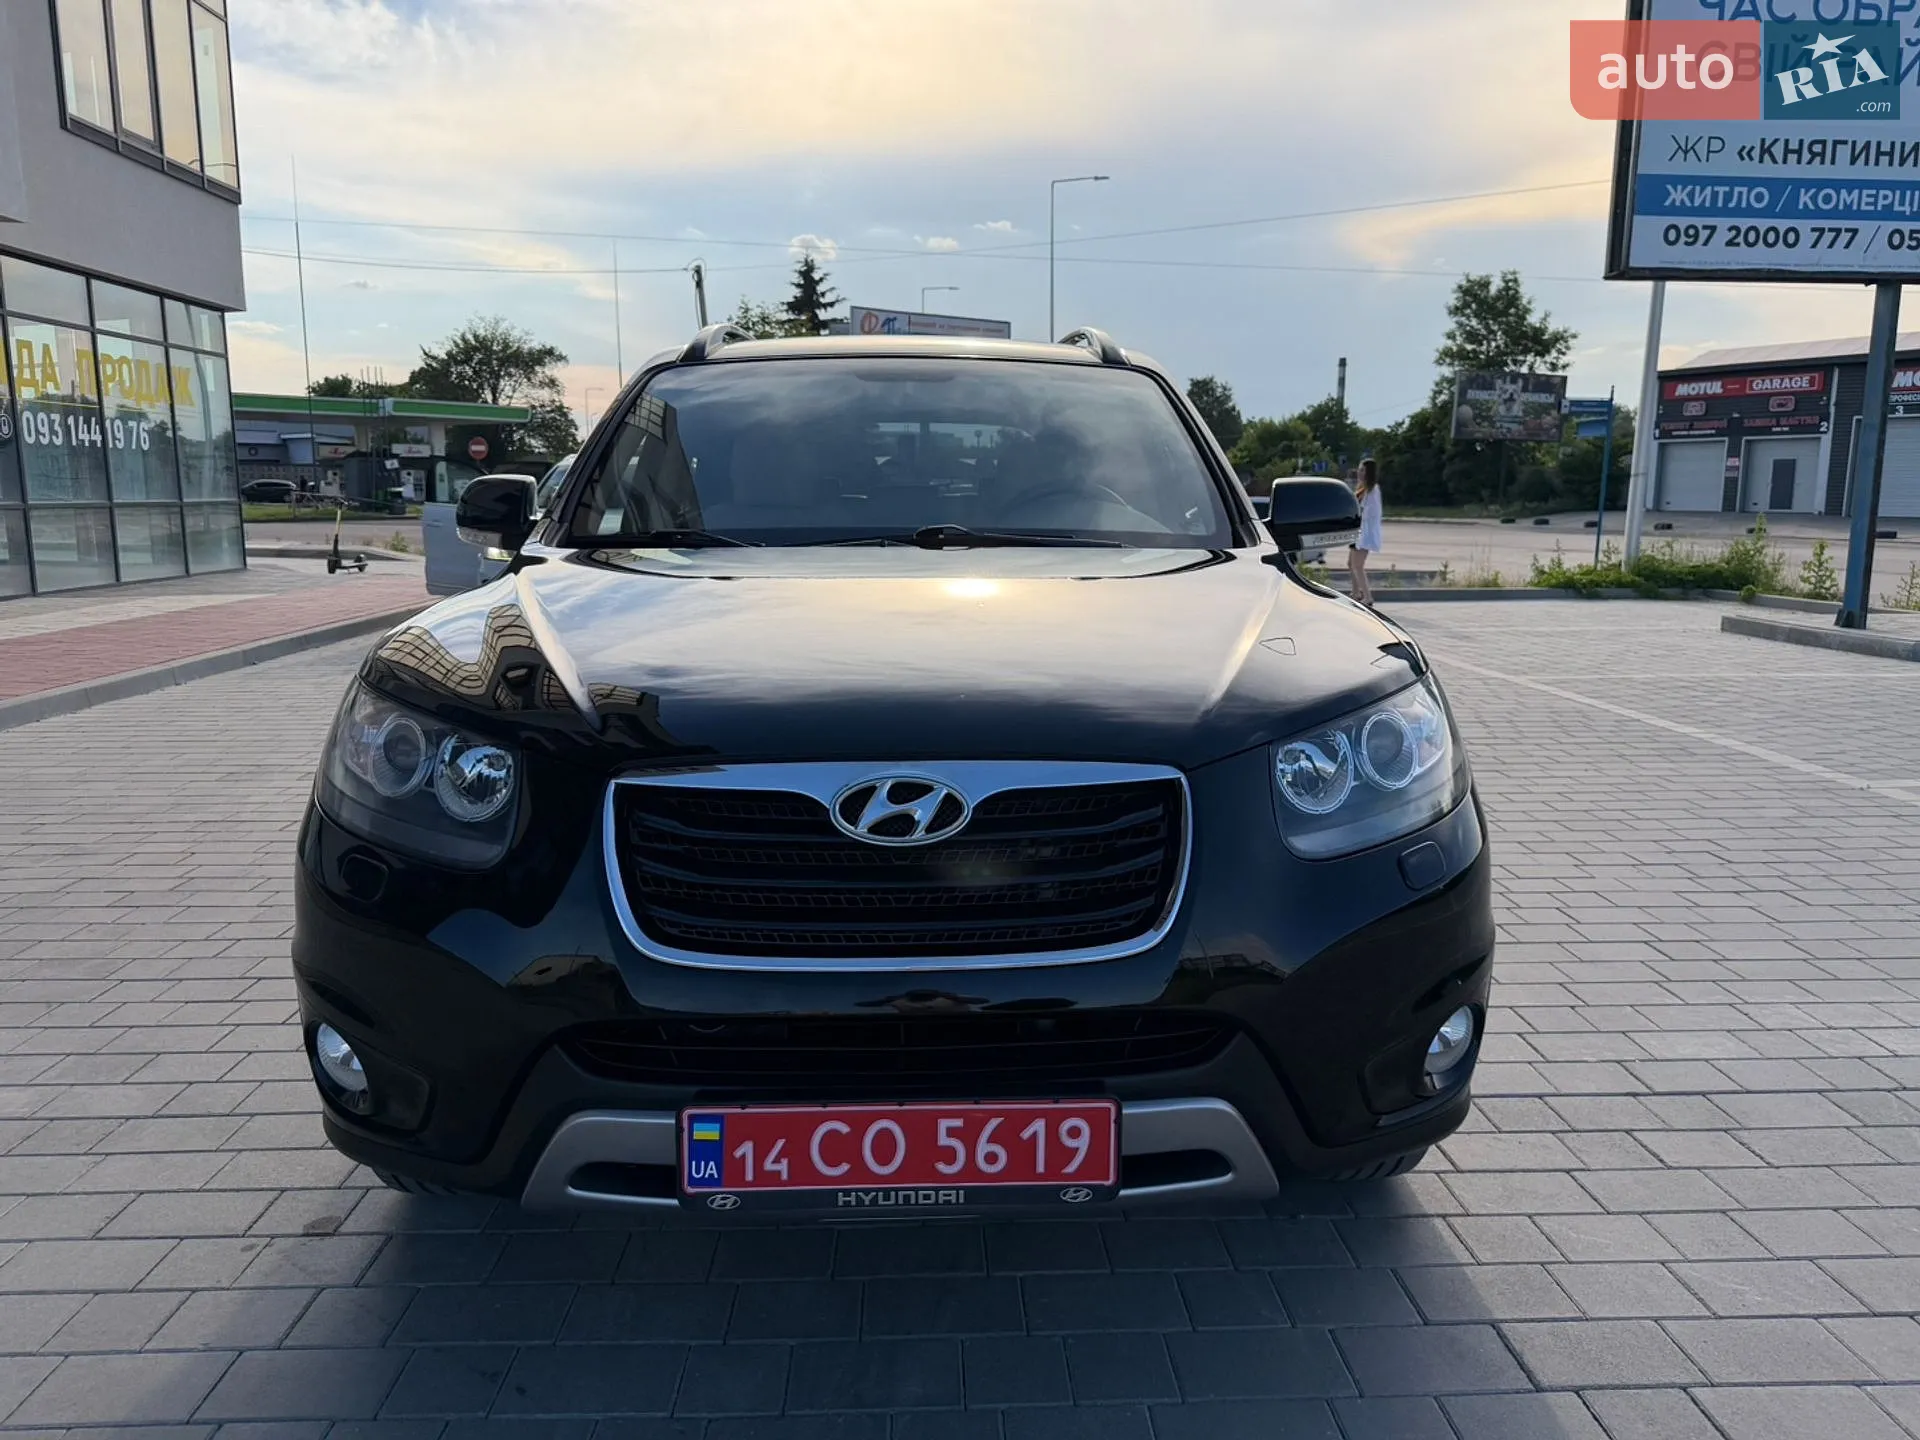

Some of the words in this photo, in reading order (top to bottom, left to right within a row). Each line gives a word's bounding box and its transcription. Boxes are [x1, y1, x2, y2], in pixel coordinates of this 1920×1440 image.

[1813, 0, 1920, 29] ОБР
[1668, 134, 1726, 163] ЖР
[1663, 184, 1770, 209] ЖИТЛО
[1662, 223, 1718, 247] 097
[1724, 225, 1801, 249] 2000
[1809, 227, 1860, 250] 777
[76, 348, 196, 410] ПРОДАЖ
[1675, 380, 1723, 396] MOTUL
[1752, 375, 1810, 391] GARAGE
[22, 411, 64, 445] 093
[67, 414, 103, 448] 144
[105, 418, 125, 449] 19
[128, 420, 150, 451] 76
[1819, 421, 1829, 432] 2
[691, 1160, 719, 1180] UA
[732, 1138, 790, 1182] 14
[809, 1119, 907, 1177] CO
[933, 1117, 1092, 1175] 5619
[836, 1189, 965, 1207] HYUNDAI
